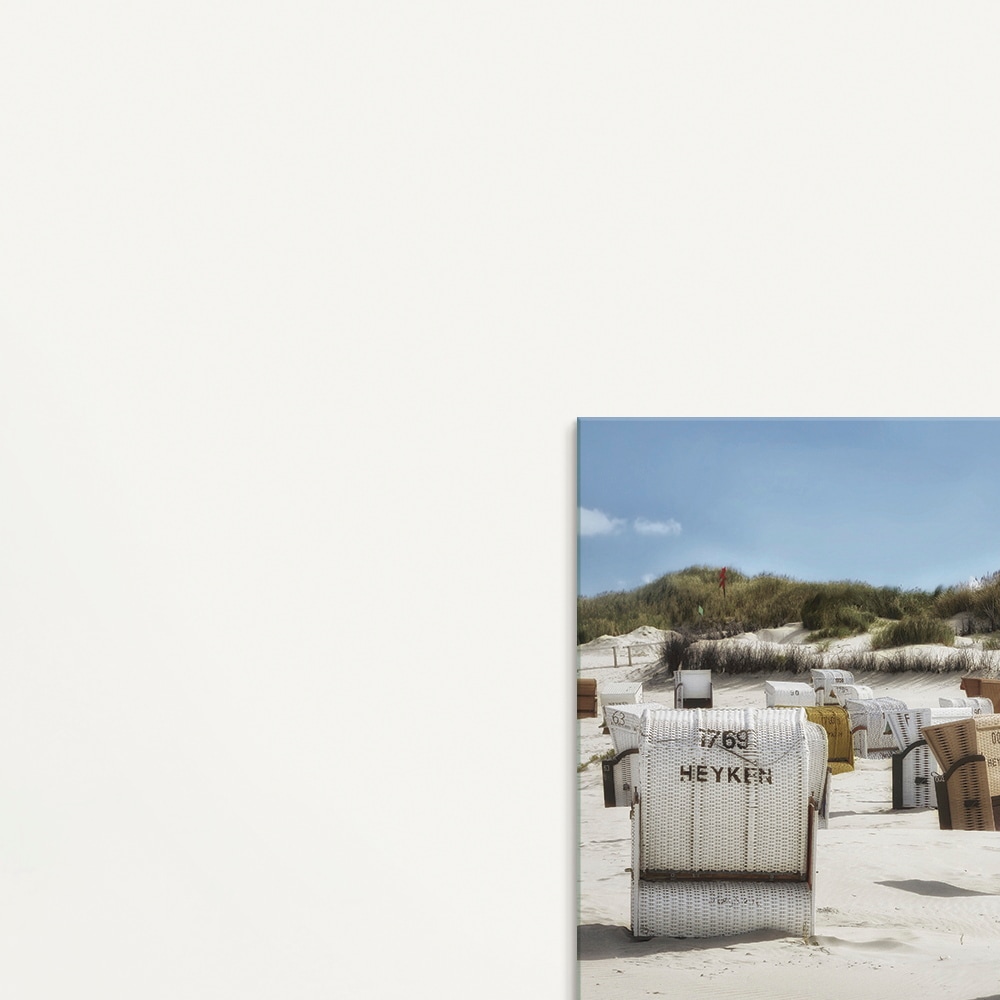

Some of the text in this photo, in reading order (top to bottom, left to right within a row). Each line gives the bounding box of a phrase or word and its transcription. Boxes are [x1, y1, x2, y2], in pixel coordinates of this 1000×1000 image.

[612, 710, 626, 726] 63
[699, 729, 749, 749] 1769
[680, 765, 772, 784] HEYKEN
